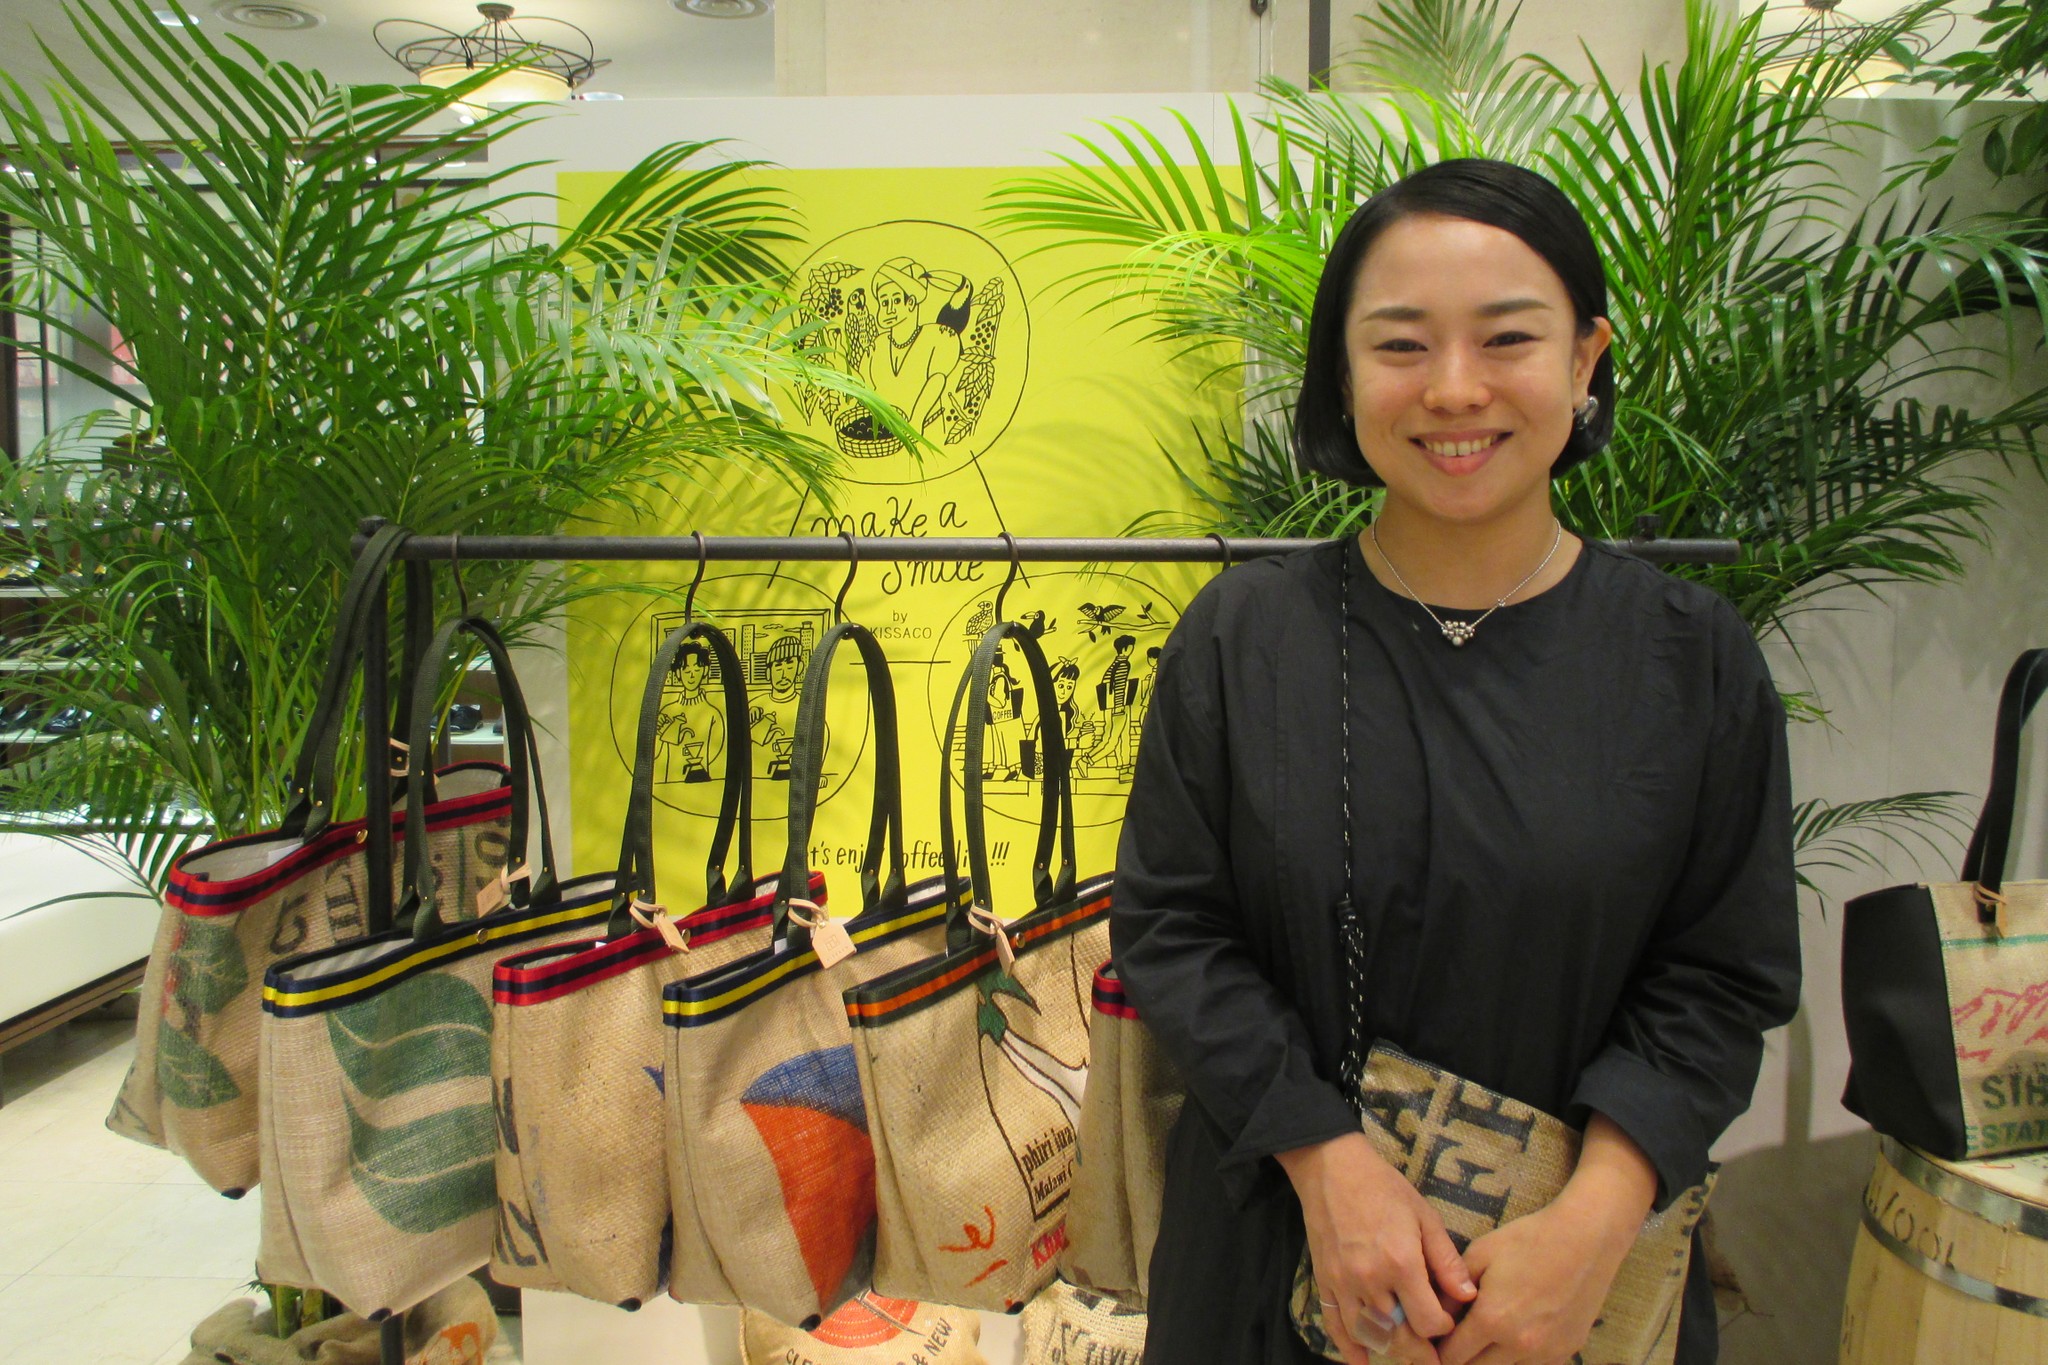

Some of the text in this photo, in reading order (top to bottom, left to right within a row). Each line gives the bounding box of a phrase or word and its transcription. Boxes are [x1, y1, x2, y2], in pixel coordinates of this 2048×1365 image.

[939, 501, 968, 528] a
[892, 610, 908, 622] by
[870, 627, 932, 639] KISSACO
[992, 709, 1013, 720] COFFEE
[924, 1317, 952, 1356] NEW
